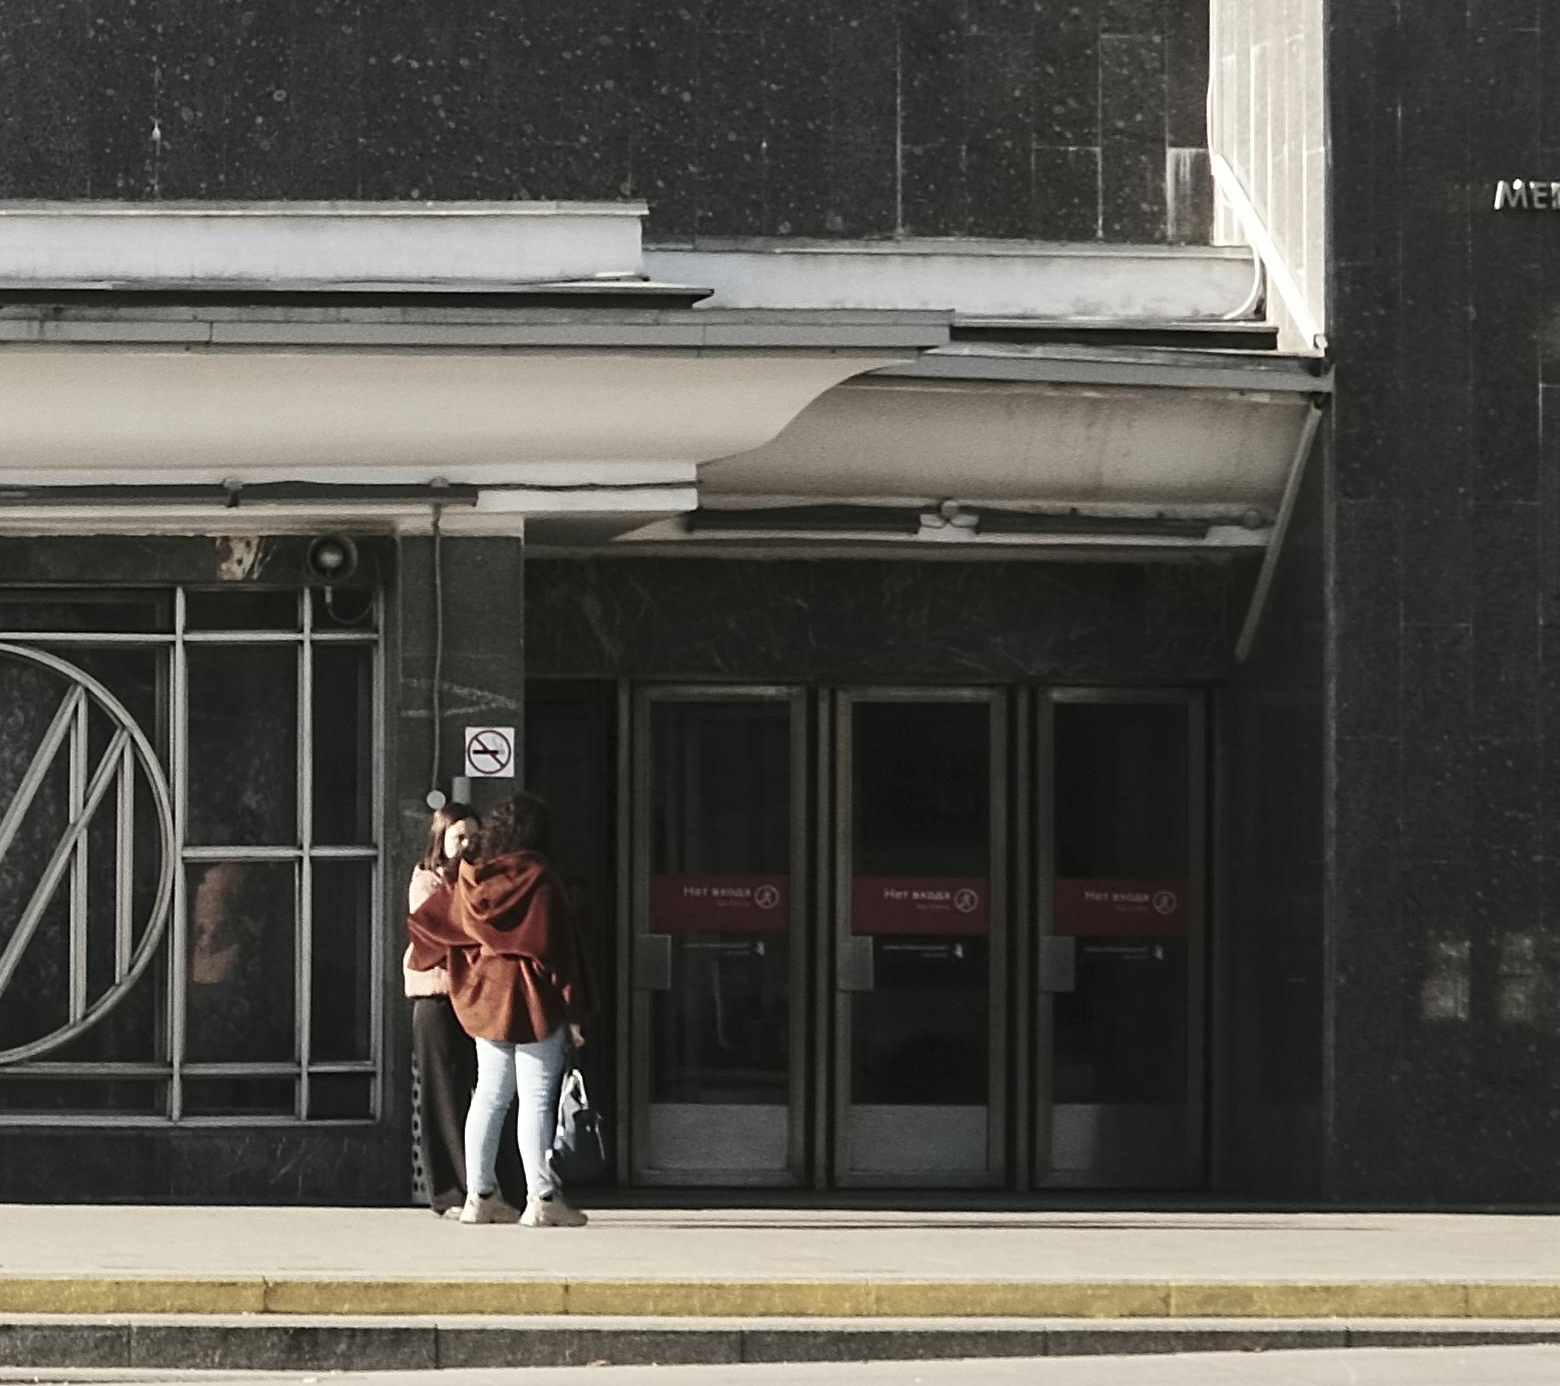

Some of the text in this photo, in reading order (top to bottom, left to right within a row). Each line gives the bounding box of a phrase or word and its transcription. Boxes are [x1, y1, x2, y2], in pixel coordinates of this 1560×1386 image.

[683, 885, 751, 898] Нет входа
[883, 887, 951, 901] Нет входа
[1084, 890, 1150, 903] Нет входа
